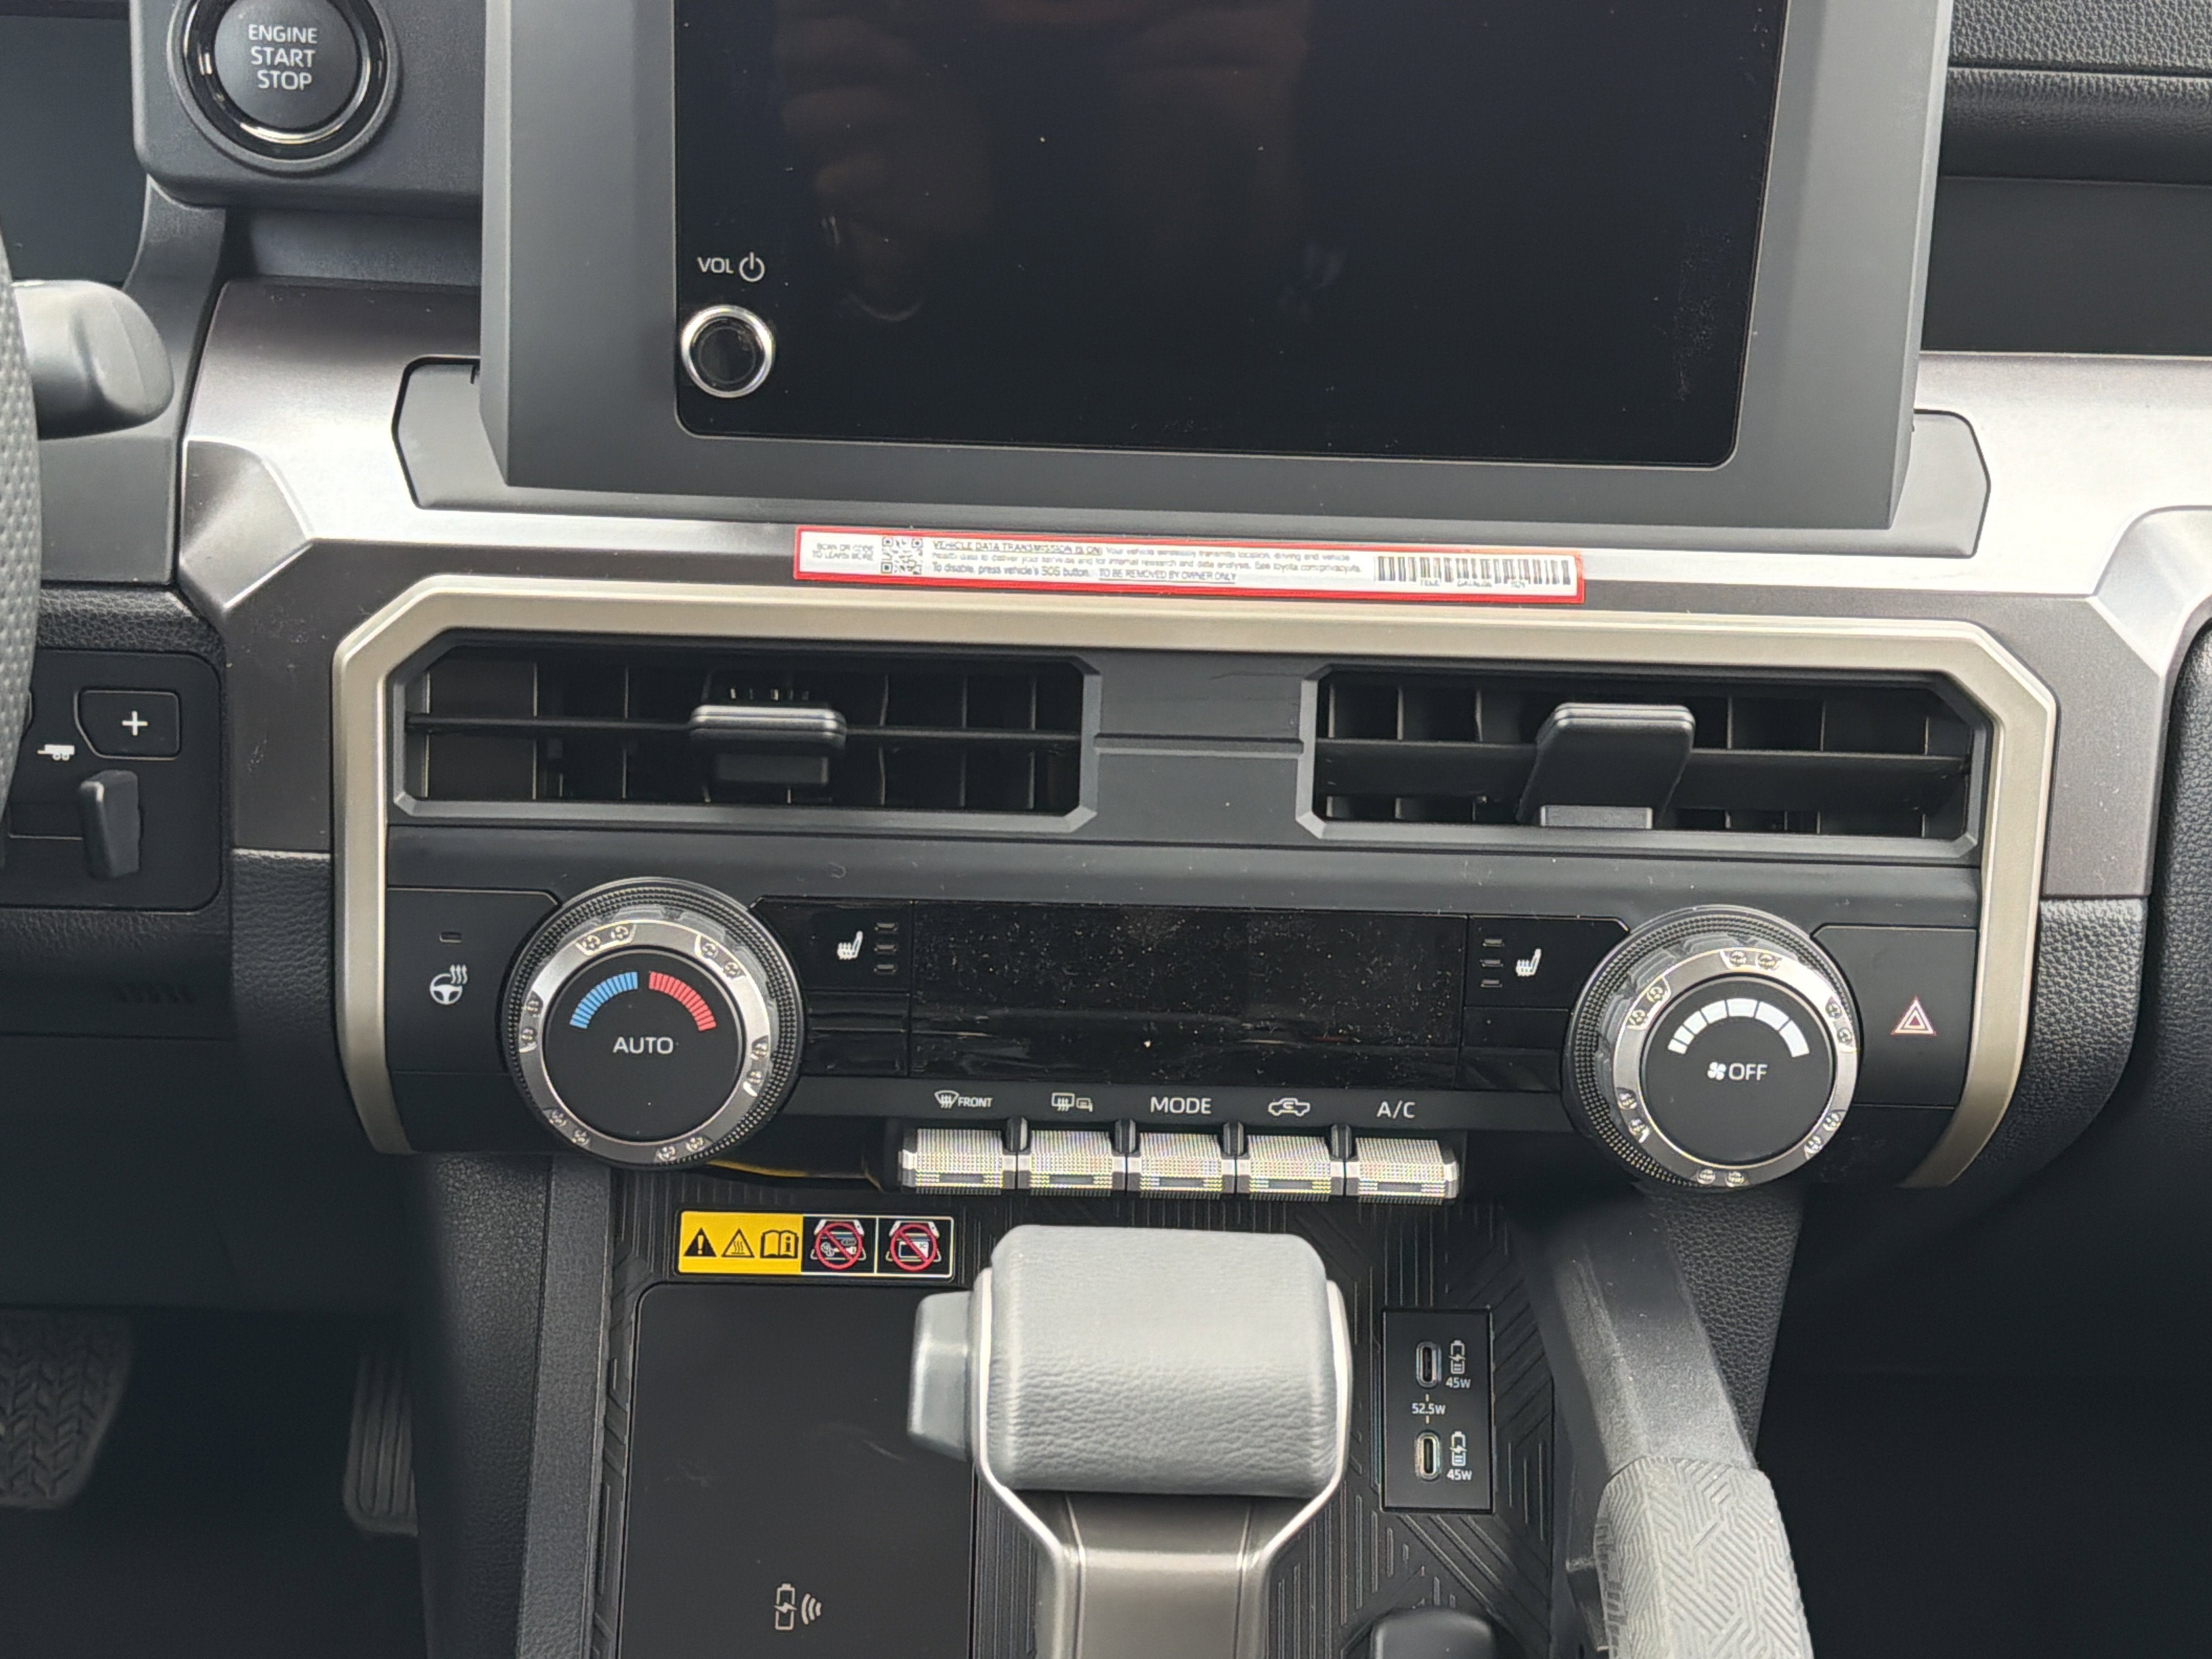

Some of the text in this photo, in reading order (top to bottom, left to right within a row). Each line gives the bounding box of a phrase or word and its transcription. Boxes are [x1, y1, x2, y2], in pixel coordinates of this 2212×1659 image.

[249, 24, 318, 43] ENGINE
[251, 47, 315, 68] START
[258, 70, 312, 91] STOP
[697, 257, 734, 274] VOL
[975, 542, 1000, 551] DATA
[932, 561, 942, 572] To
[978, 565, 1001, 575] press
[1041, 566, 1060, 575] SOS
[1099, 568, 1110, 577] TO
[1112, 569, 1122, 577] BE
[1125, 569, 1167, 579] REMOVED
[1169, 571, 1179, 579] BY
[1181, 571, 1212, 580] OWNER
[613, 1036, 674, 1055] AUTO
[1729, 1063, 1768, 1081] OFF
[958, 1097, 993, 1108] FRONT
[1150, 1097, 1212, 1114] MODE
[1376, 1099, 1416, 1119] A/C
[1446, 1377, 1471, 1389] 45W
[1412, 1402, 1446, 1415] 52.5W
[1447, 1469, 1472, 1481] 45W
